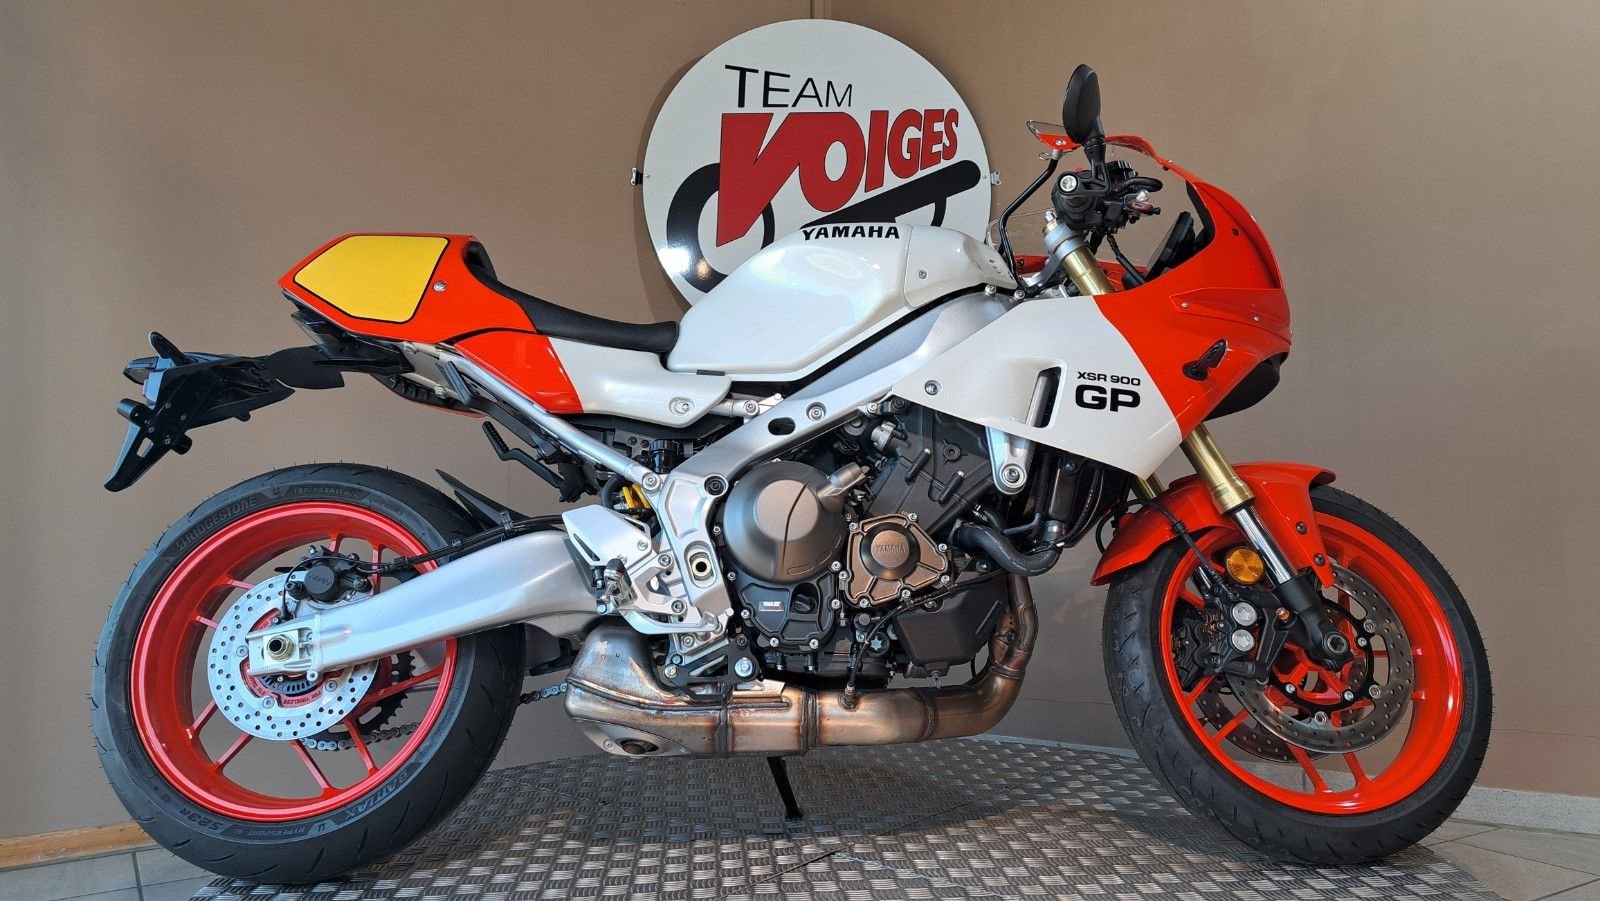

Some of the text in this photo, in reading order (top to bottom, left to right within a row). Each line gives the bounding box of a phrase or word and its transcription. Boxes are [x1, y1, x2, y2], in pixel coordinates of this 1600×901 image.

[725, 64, 853, 108] TEAM
[715, 108, 959, 248] VOIGES
[802, 225, 900, 241] YAMAHA
[1077, 371, 1141, 386] XSR 900
[1075, 384, 1141, 412] GP
[174, 498, 257, 550] BRIDGESTONE
[875, 544, 906, 553] YAMAHA
